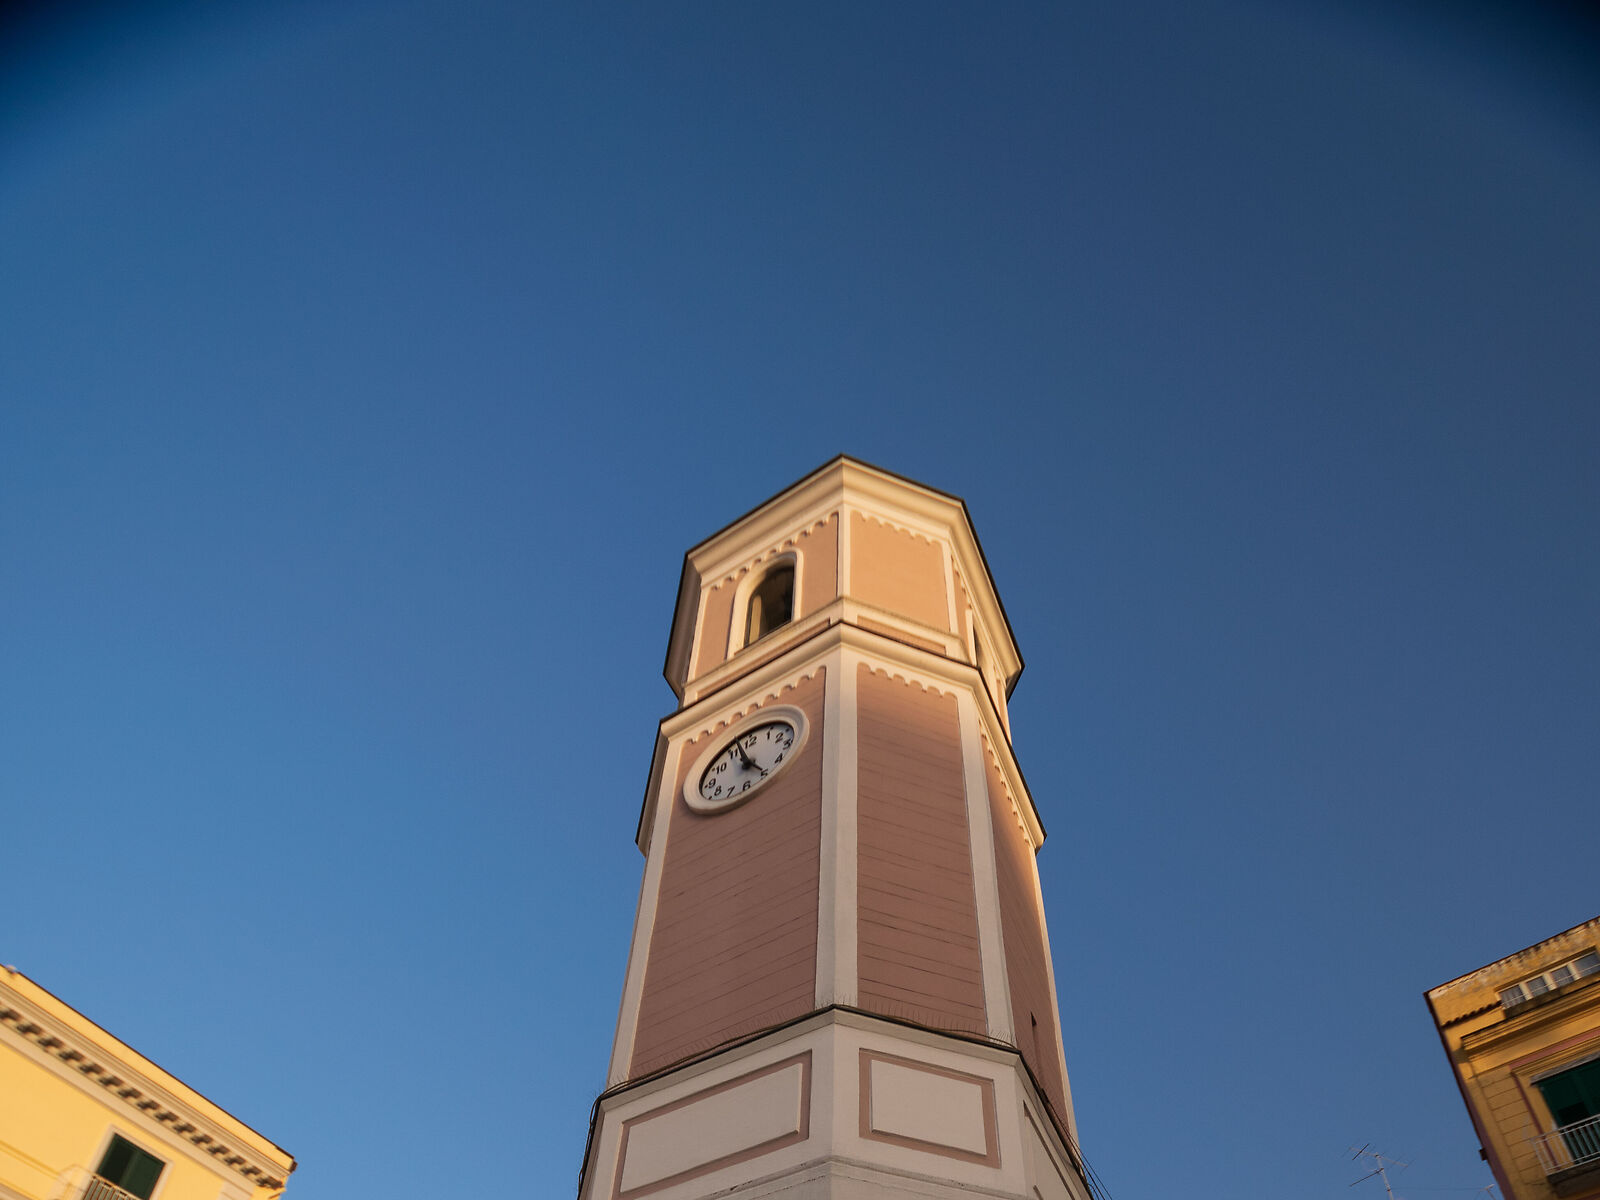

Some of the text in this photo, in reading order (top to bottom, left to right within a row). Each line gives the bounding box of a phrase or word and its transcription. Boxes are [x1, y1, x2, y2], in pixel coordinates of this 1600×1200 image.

[744, 736, 757, 749] 12
[775, 733, 783, 743] 2
[783, 740, 792, 750] 3
[774, 753, 783, 764] 4
[716, 763, 727, 774] 10
[760, 769, 769, 780] 5
[708, 778, 716, 788] 9
[742, 780, 751, 791] 6
[714, 785, 722, 796] 8
[727, 786, 736, 797] 7
